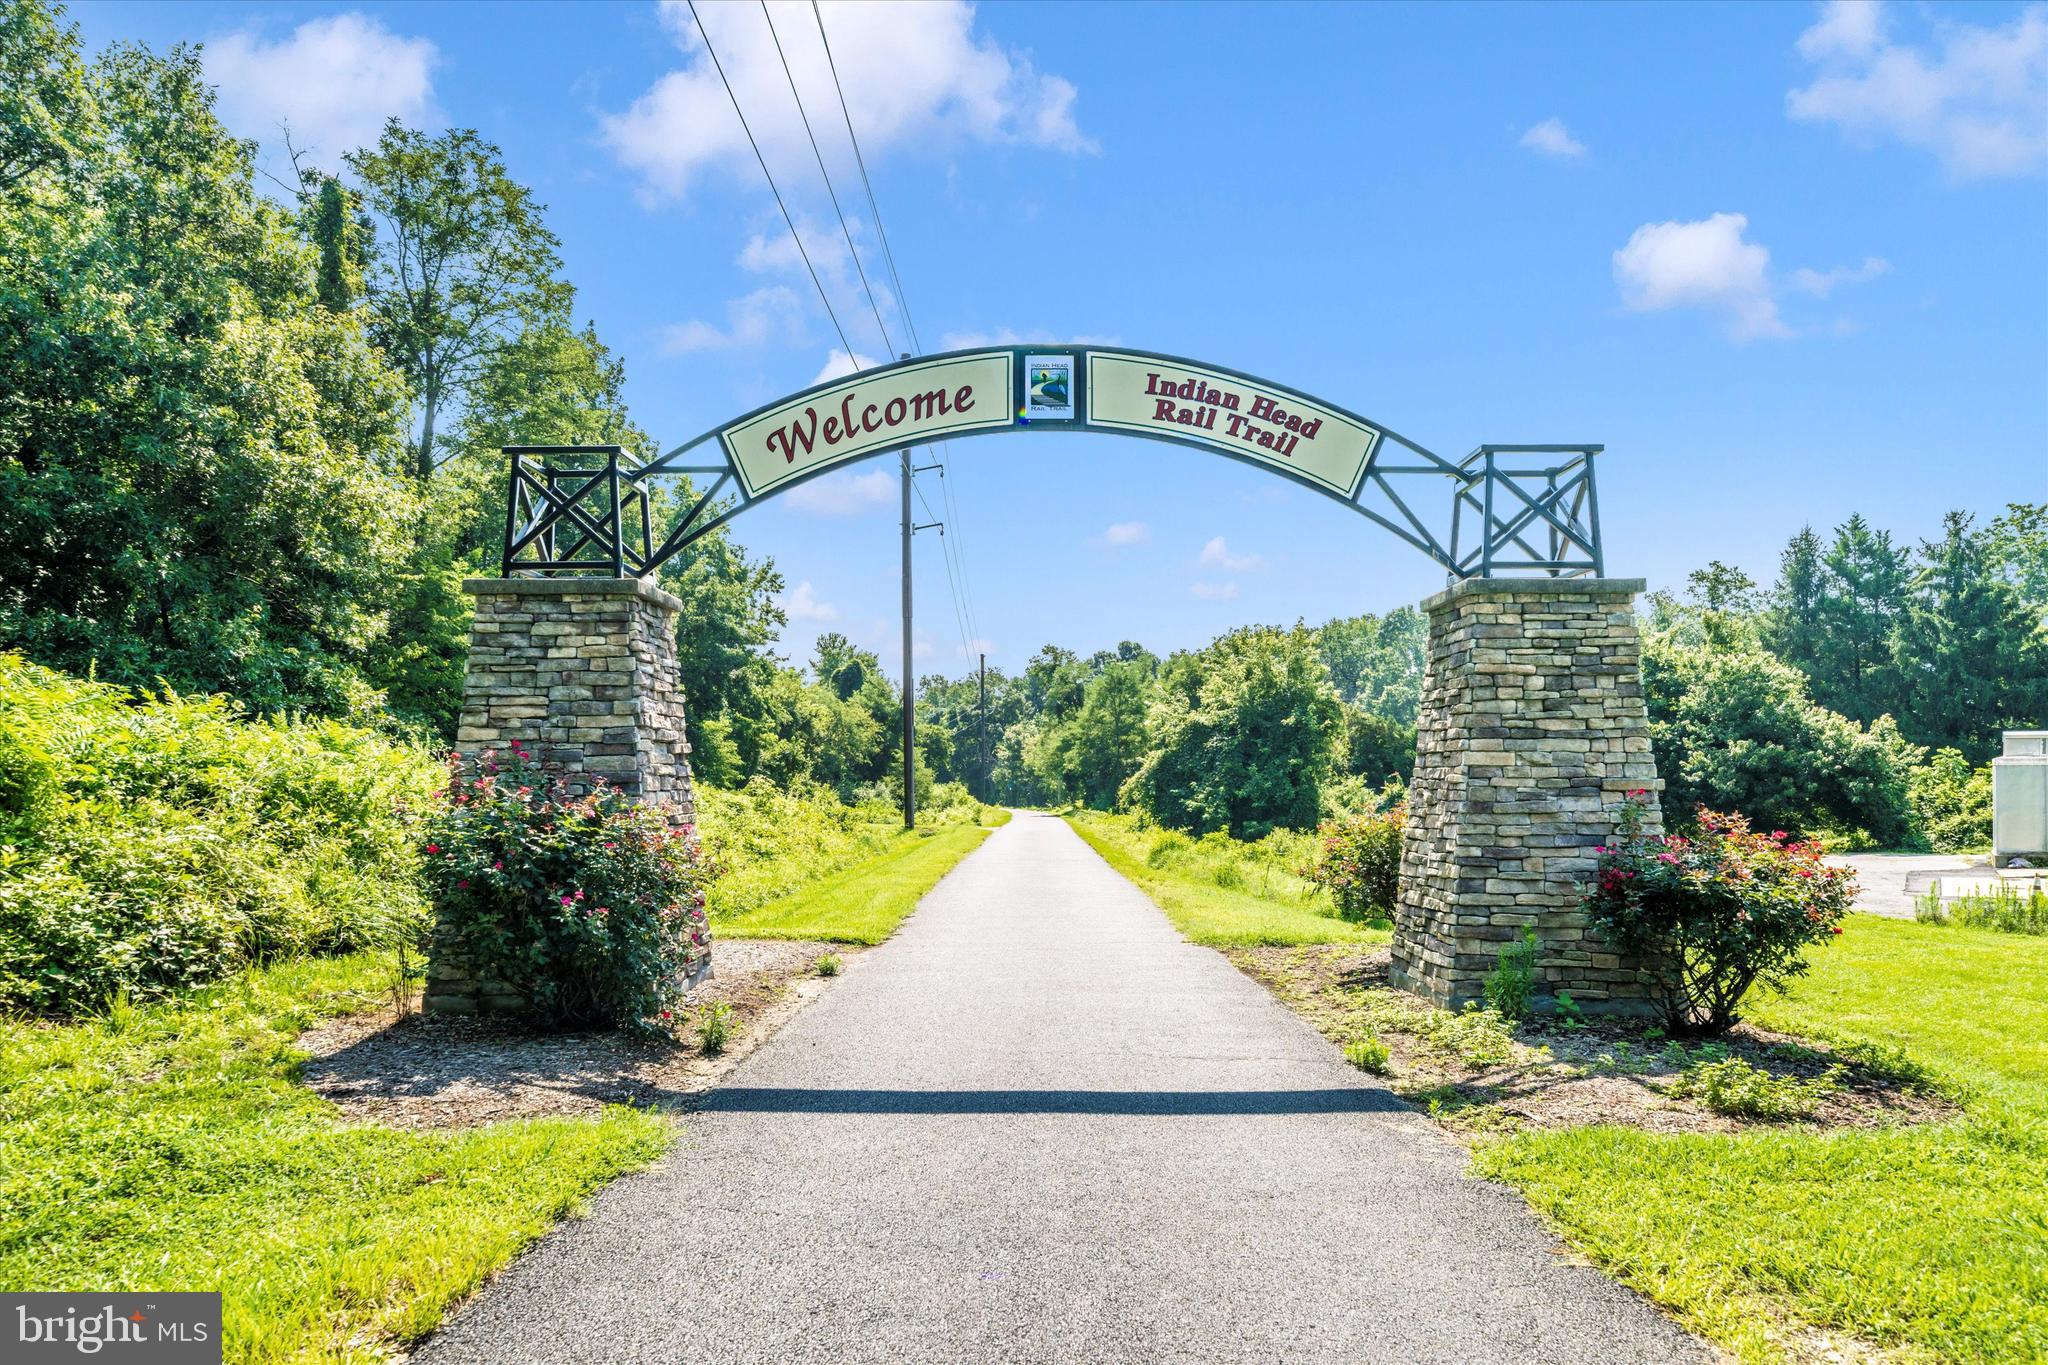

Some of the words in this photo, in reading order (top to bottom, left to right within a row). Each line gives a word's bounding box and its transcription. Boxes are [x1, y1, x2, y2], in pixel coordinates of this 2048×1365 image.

[766, 384, 976, 464] Welcome
[1144, 373, 1240, 411] Indian
[1247, 395, 1323, 440] Head
[1152, 399, 1217, 430] Rail
[1225, 413, 1300, 457] Trail
